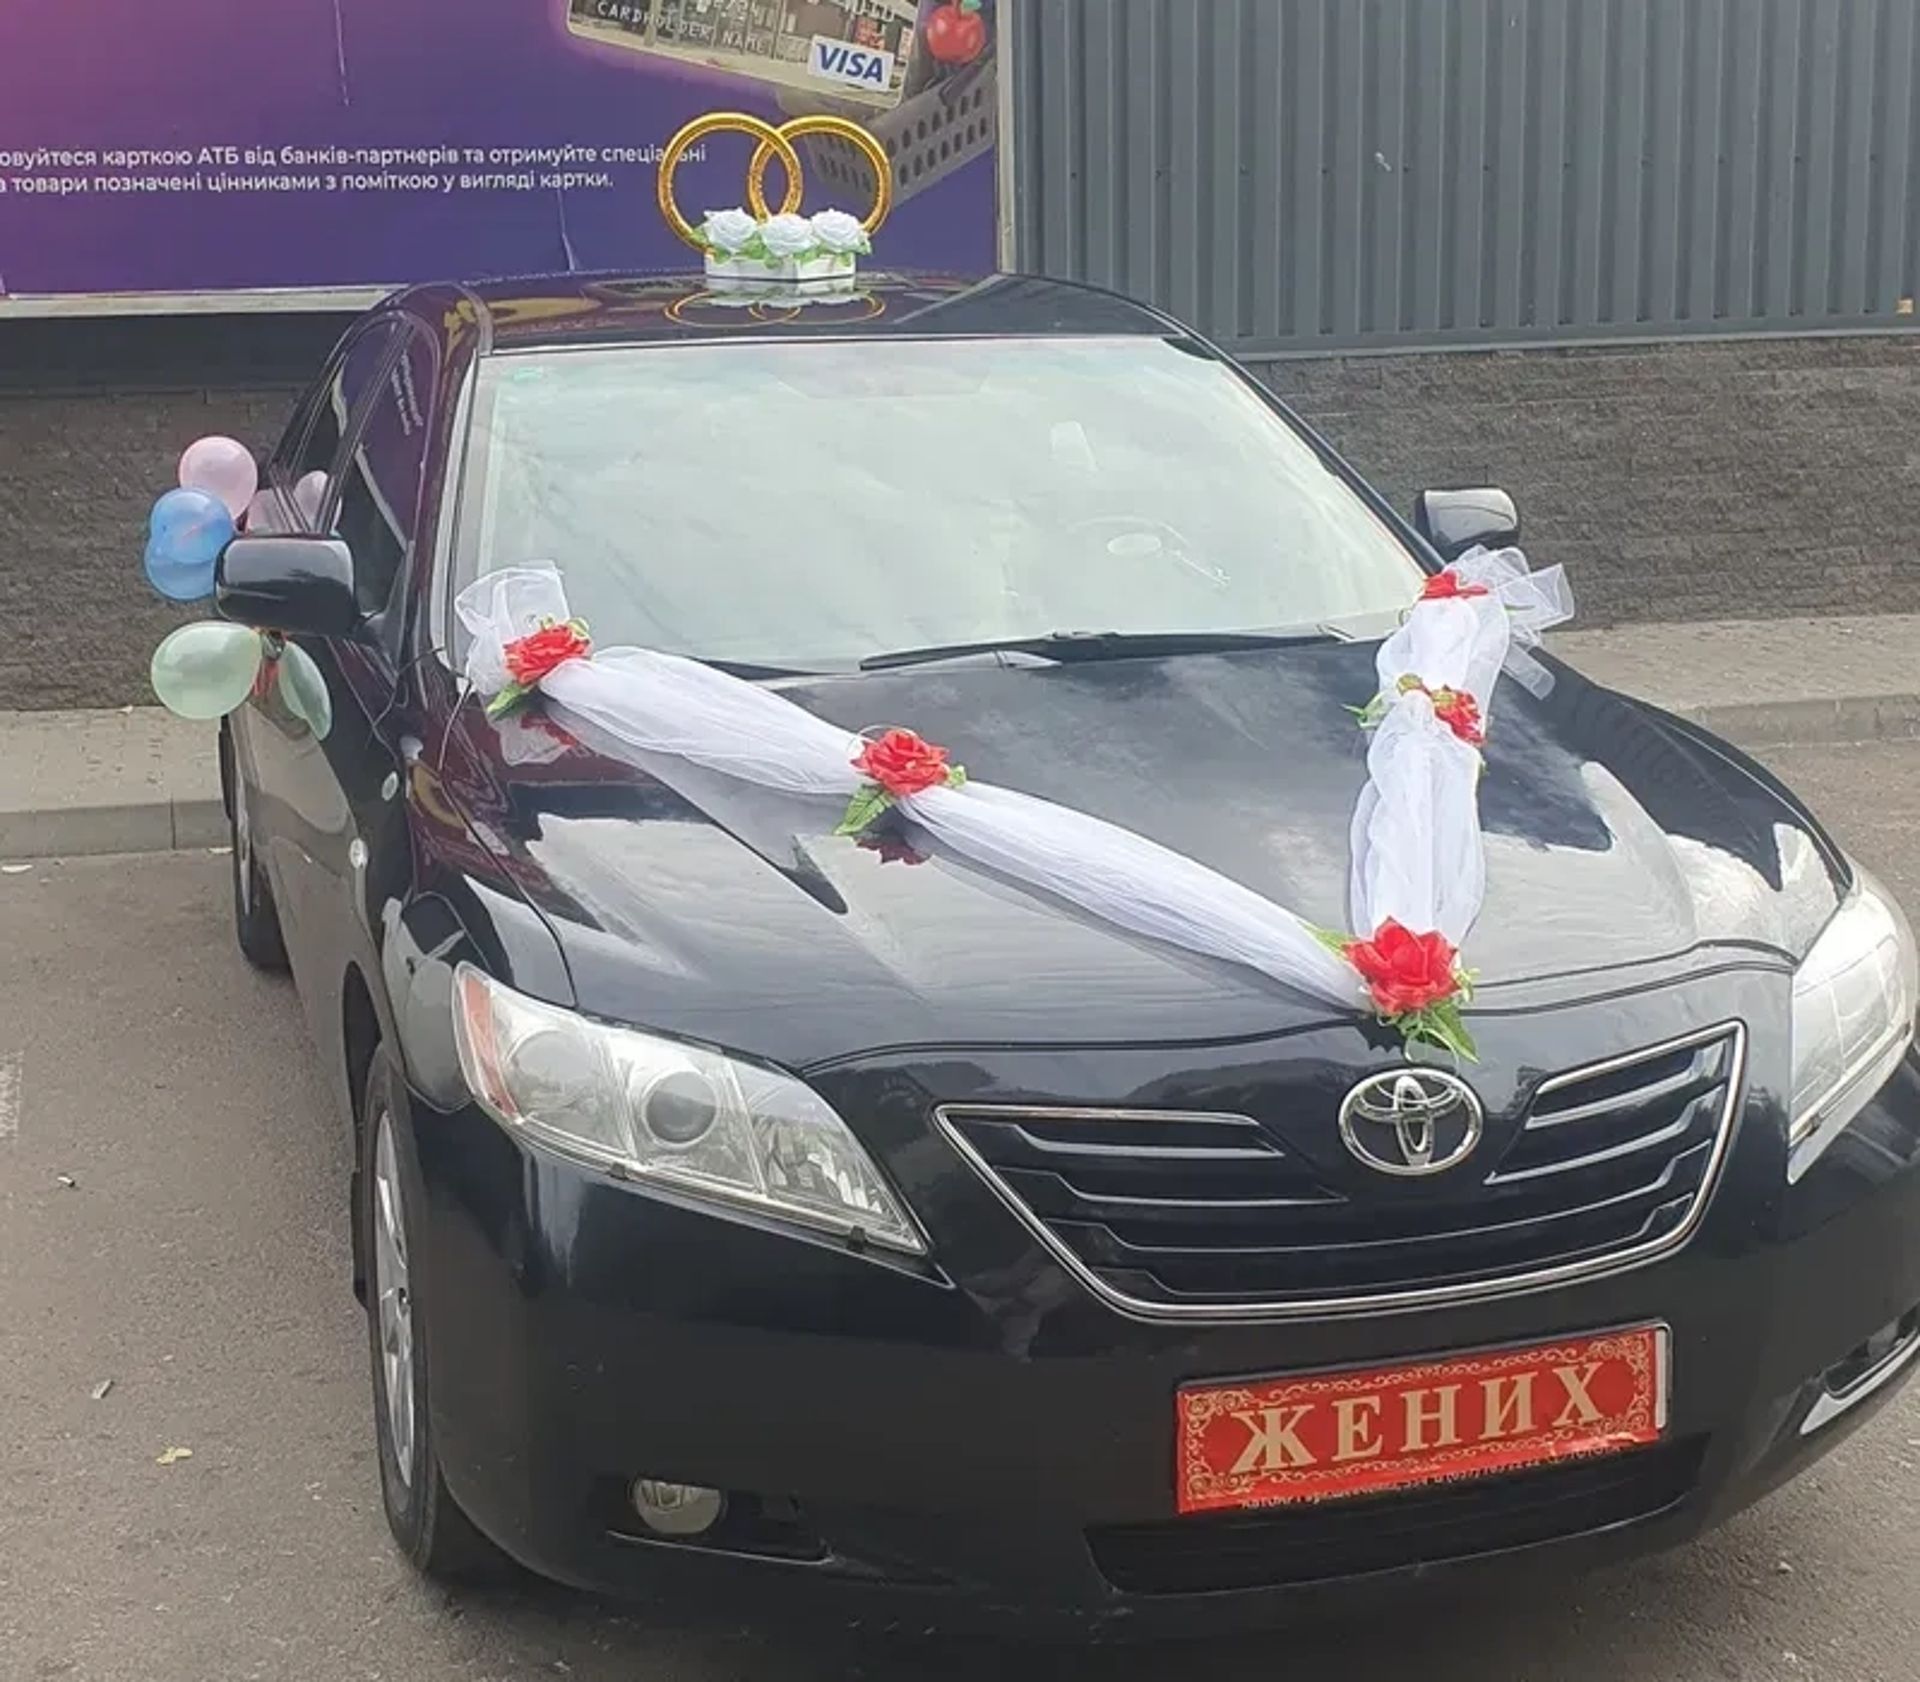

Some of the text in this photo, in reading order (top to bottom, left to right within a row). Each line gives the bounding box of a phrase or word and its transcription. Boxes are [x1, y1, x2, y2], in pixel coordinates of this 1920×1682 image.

[816, 42, 884, 83] VISA
[102, 148, 193, 168] карткою
[199, 147, 239, 165] АТБ
[244, 145, 277, 165] від
[280, 144, 459, 167] банків-партнерів
[463, 149, 485, 164] та
[489, 145, 597, 166] отримуйте
[602, 143, 707, 165] спеціаьні
[11, 177, 88, 196] товари
[94, 173, 201, 192] позначені
[207, 172, 321, 193] цінниками
[325, 174, 337, 190] з
[344, 171, 438, 190] поміткою
[442, 175, 454, 192] у
[459, 170, 536, 189] вигляді
[540, 171, 614, 188] картки.
[1229, 1361, 1604, 1475] ЖЕНИХ
